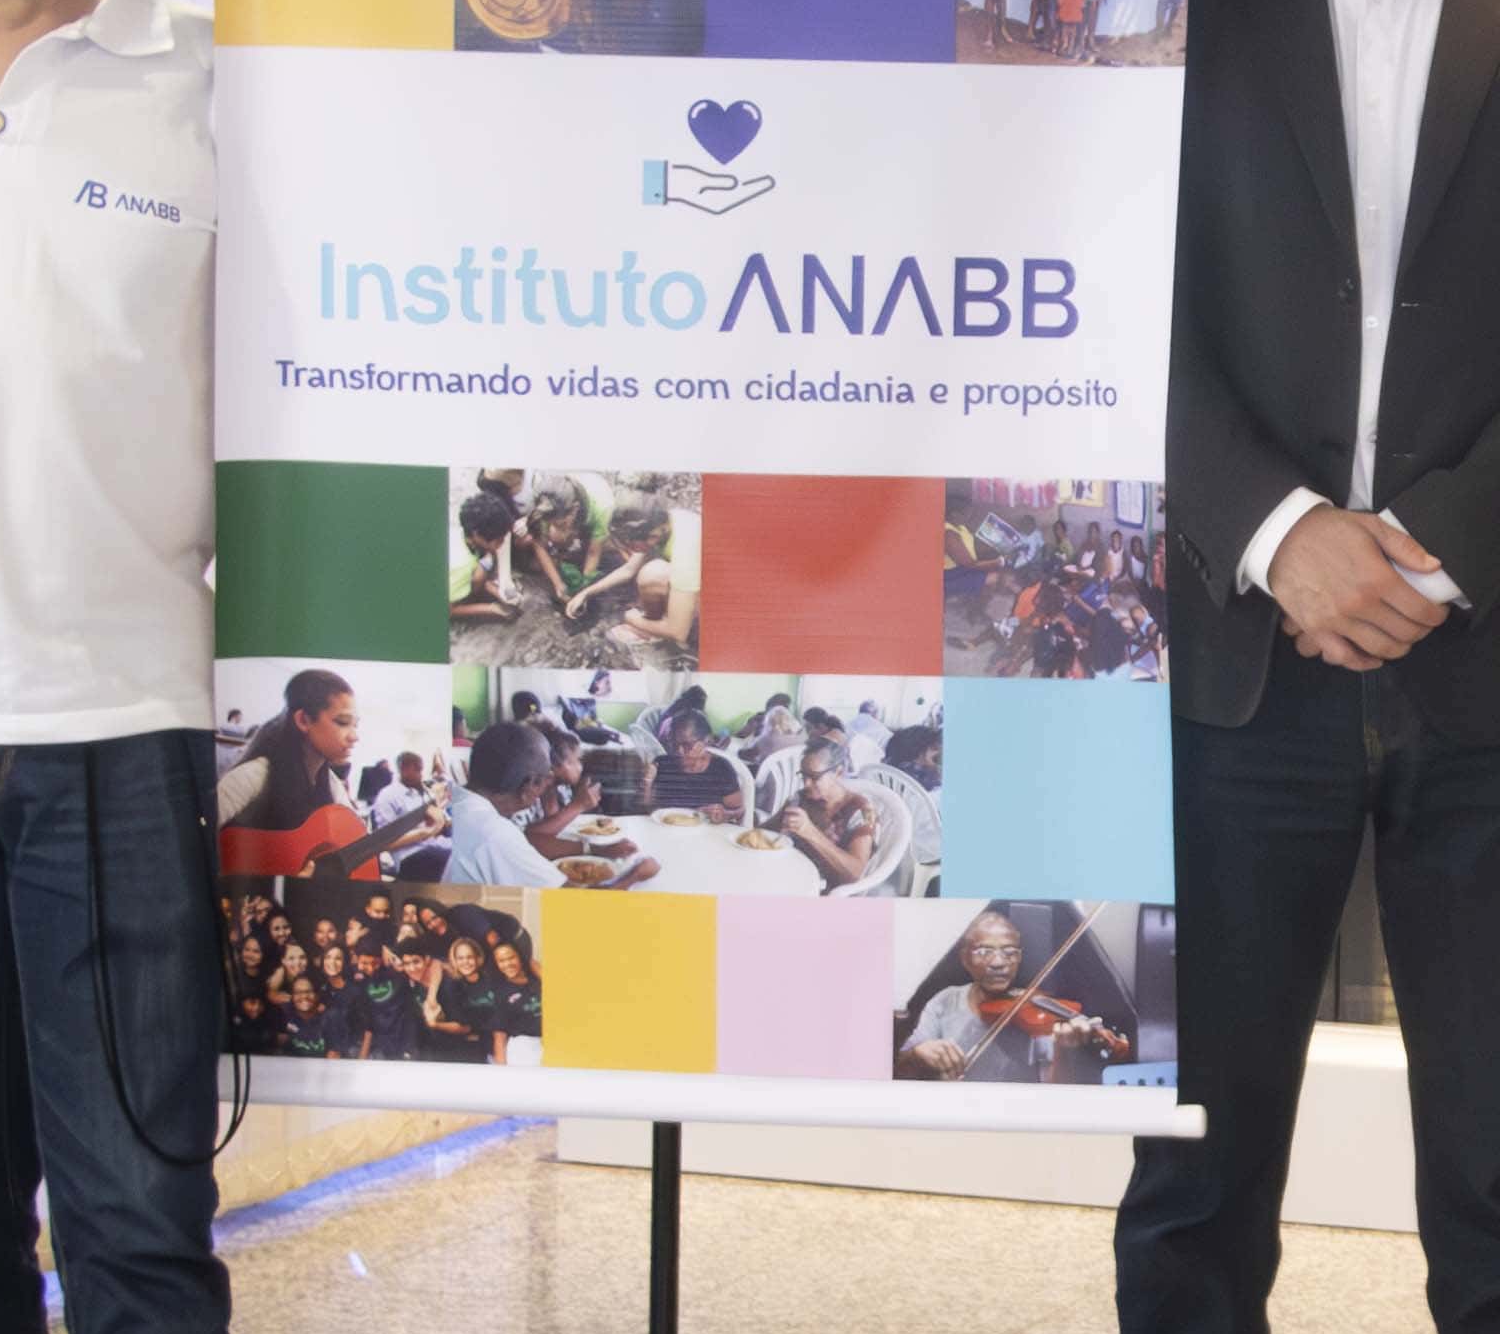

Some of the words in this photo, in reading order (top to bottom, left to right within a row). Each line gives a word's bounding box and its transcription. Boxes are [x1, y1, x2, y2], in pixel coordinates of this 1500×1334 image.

[115, 193, 181, 224] ANABB
[319, 241, 708, 332] Instituto
[717, 250, 1081, 340] ANABB
[274, 358, 533, 398] Transformando
[546, 364, 640, 400] vidas
[653, 376, 731, 402] com
[744, 368, 916, 406] cidadania
[928, 381, 949, 406] e
[963, 378, 1119, 417] propósito
